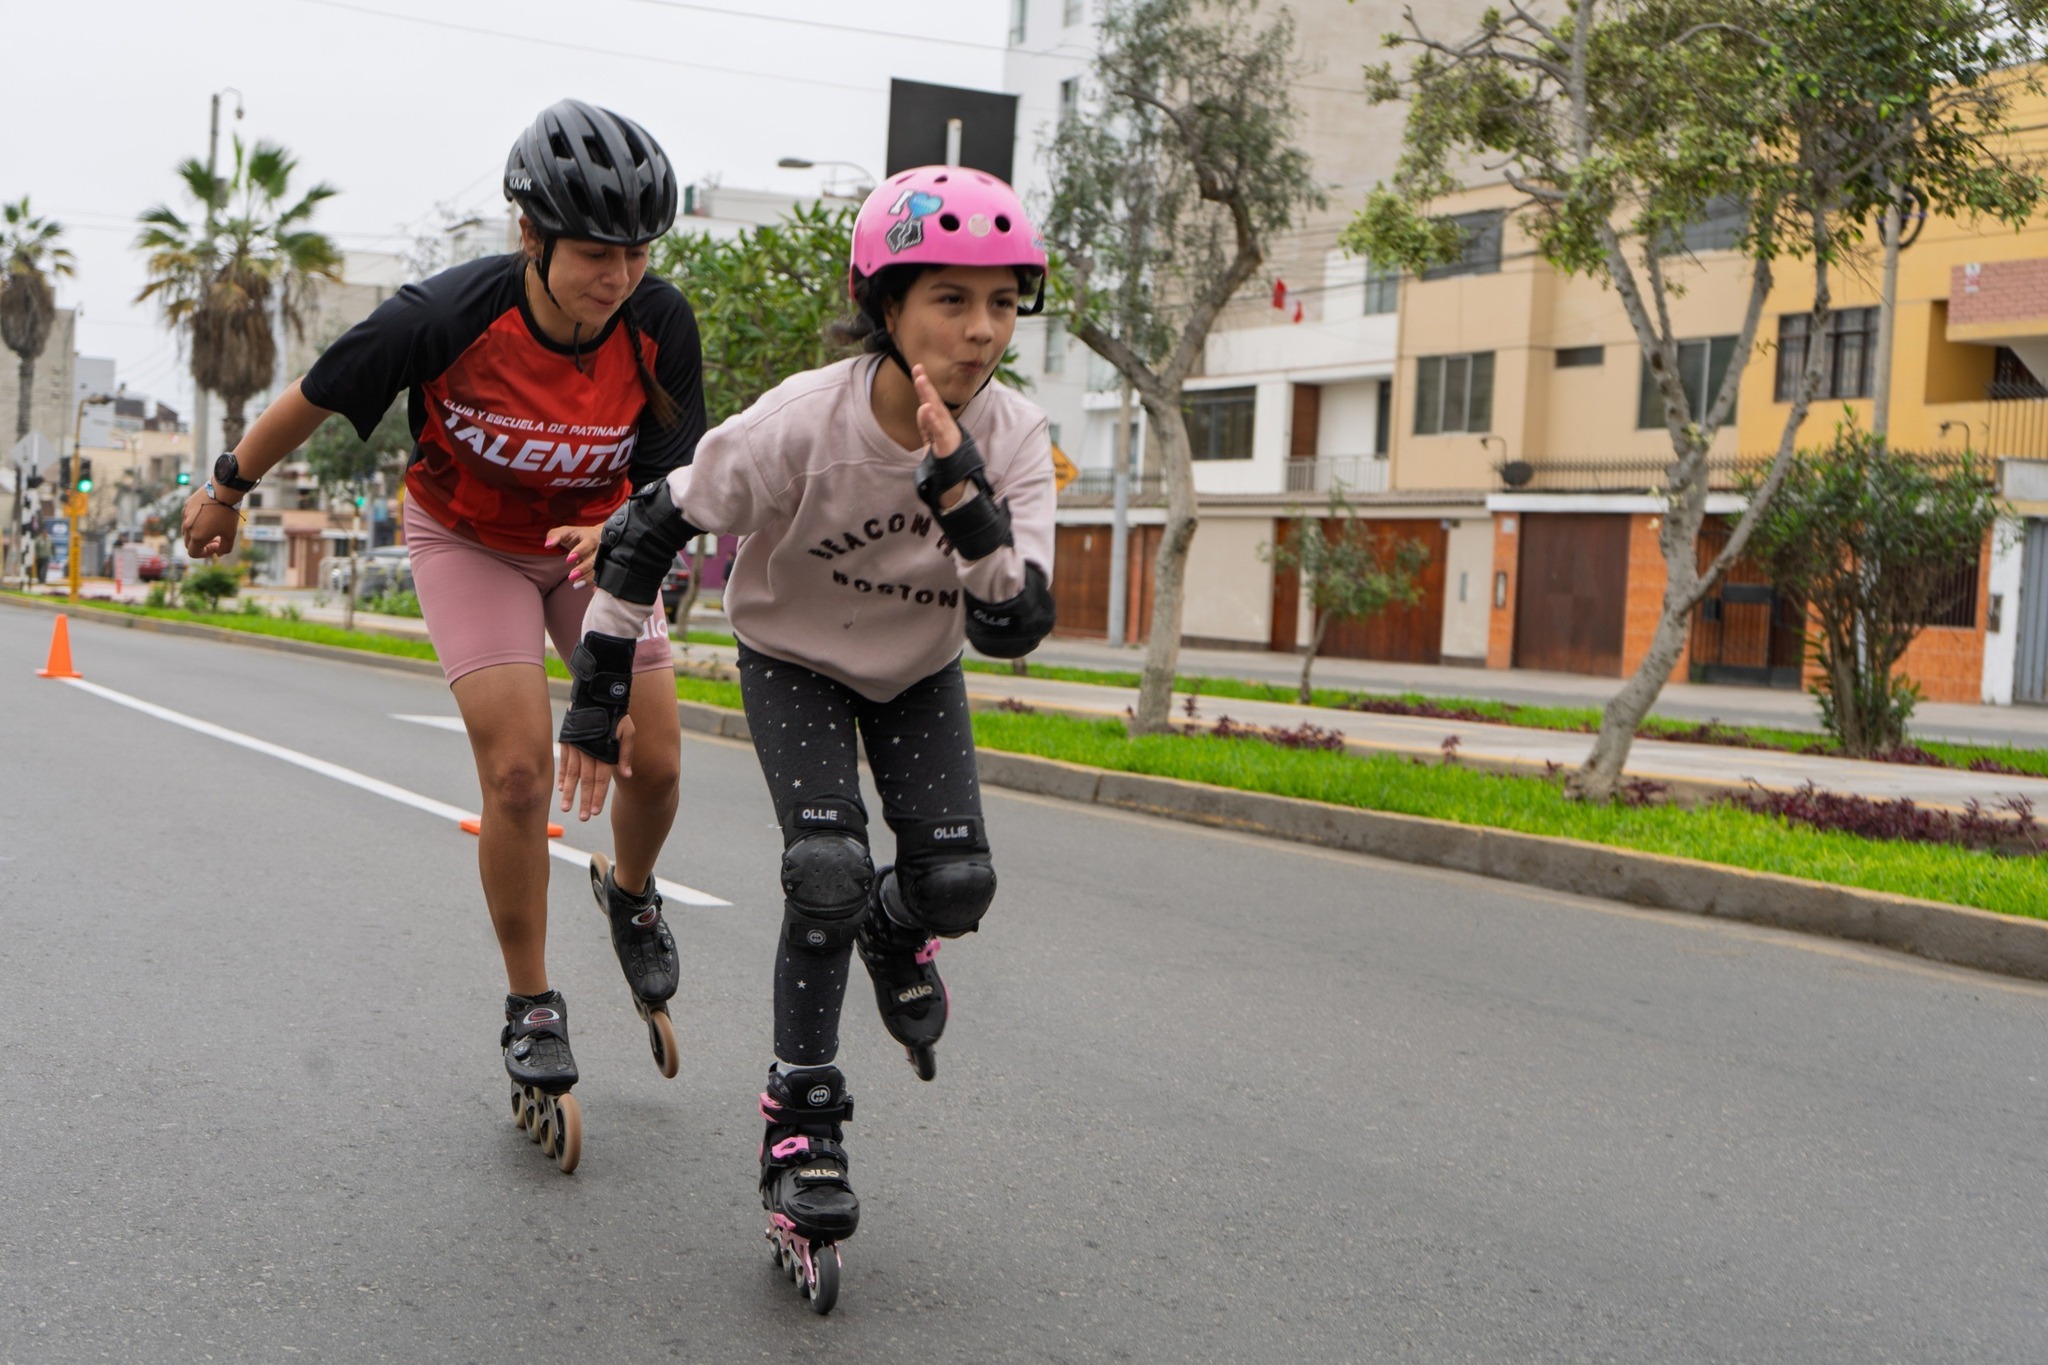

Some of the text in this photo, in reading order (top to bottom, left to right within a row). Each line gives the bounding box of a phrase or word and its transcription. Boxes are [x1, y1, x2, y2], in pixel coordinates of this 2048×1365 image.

[509, 177, 532, 192] KASK
[443, 399, 630, 437] CLUB Y ESCUELA DE PATINAJE
[444, 412, 638, 474] TALENTO
[802, 809, 838, 821] OLLIE
[934, 825, 969, 840] OLLIE
